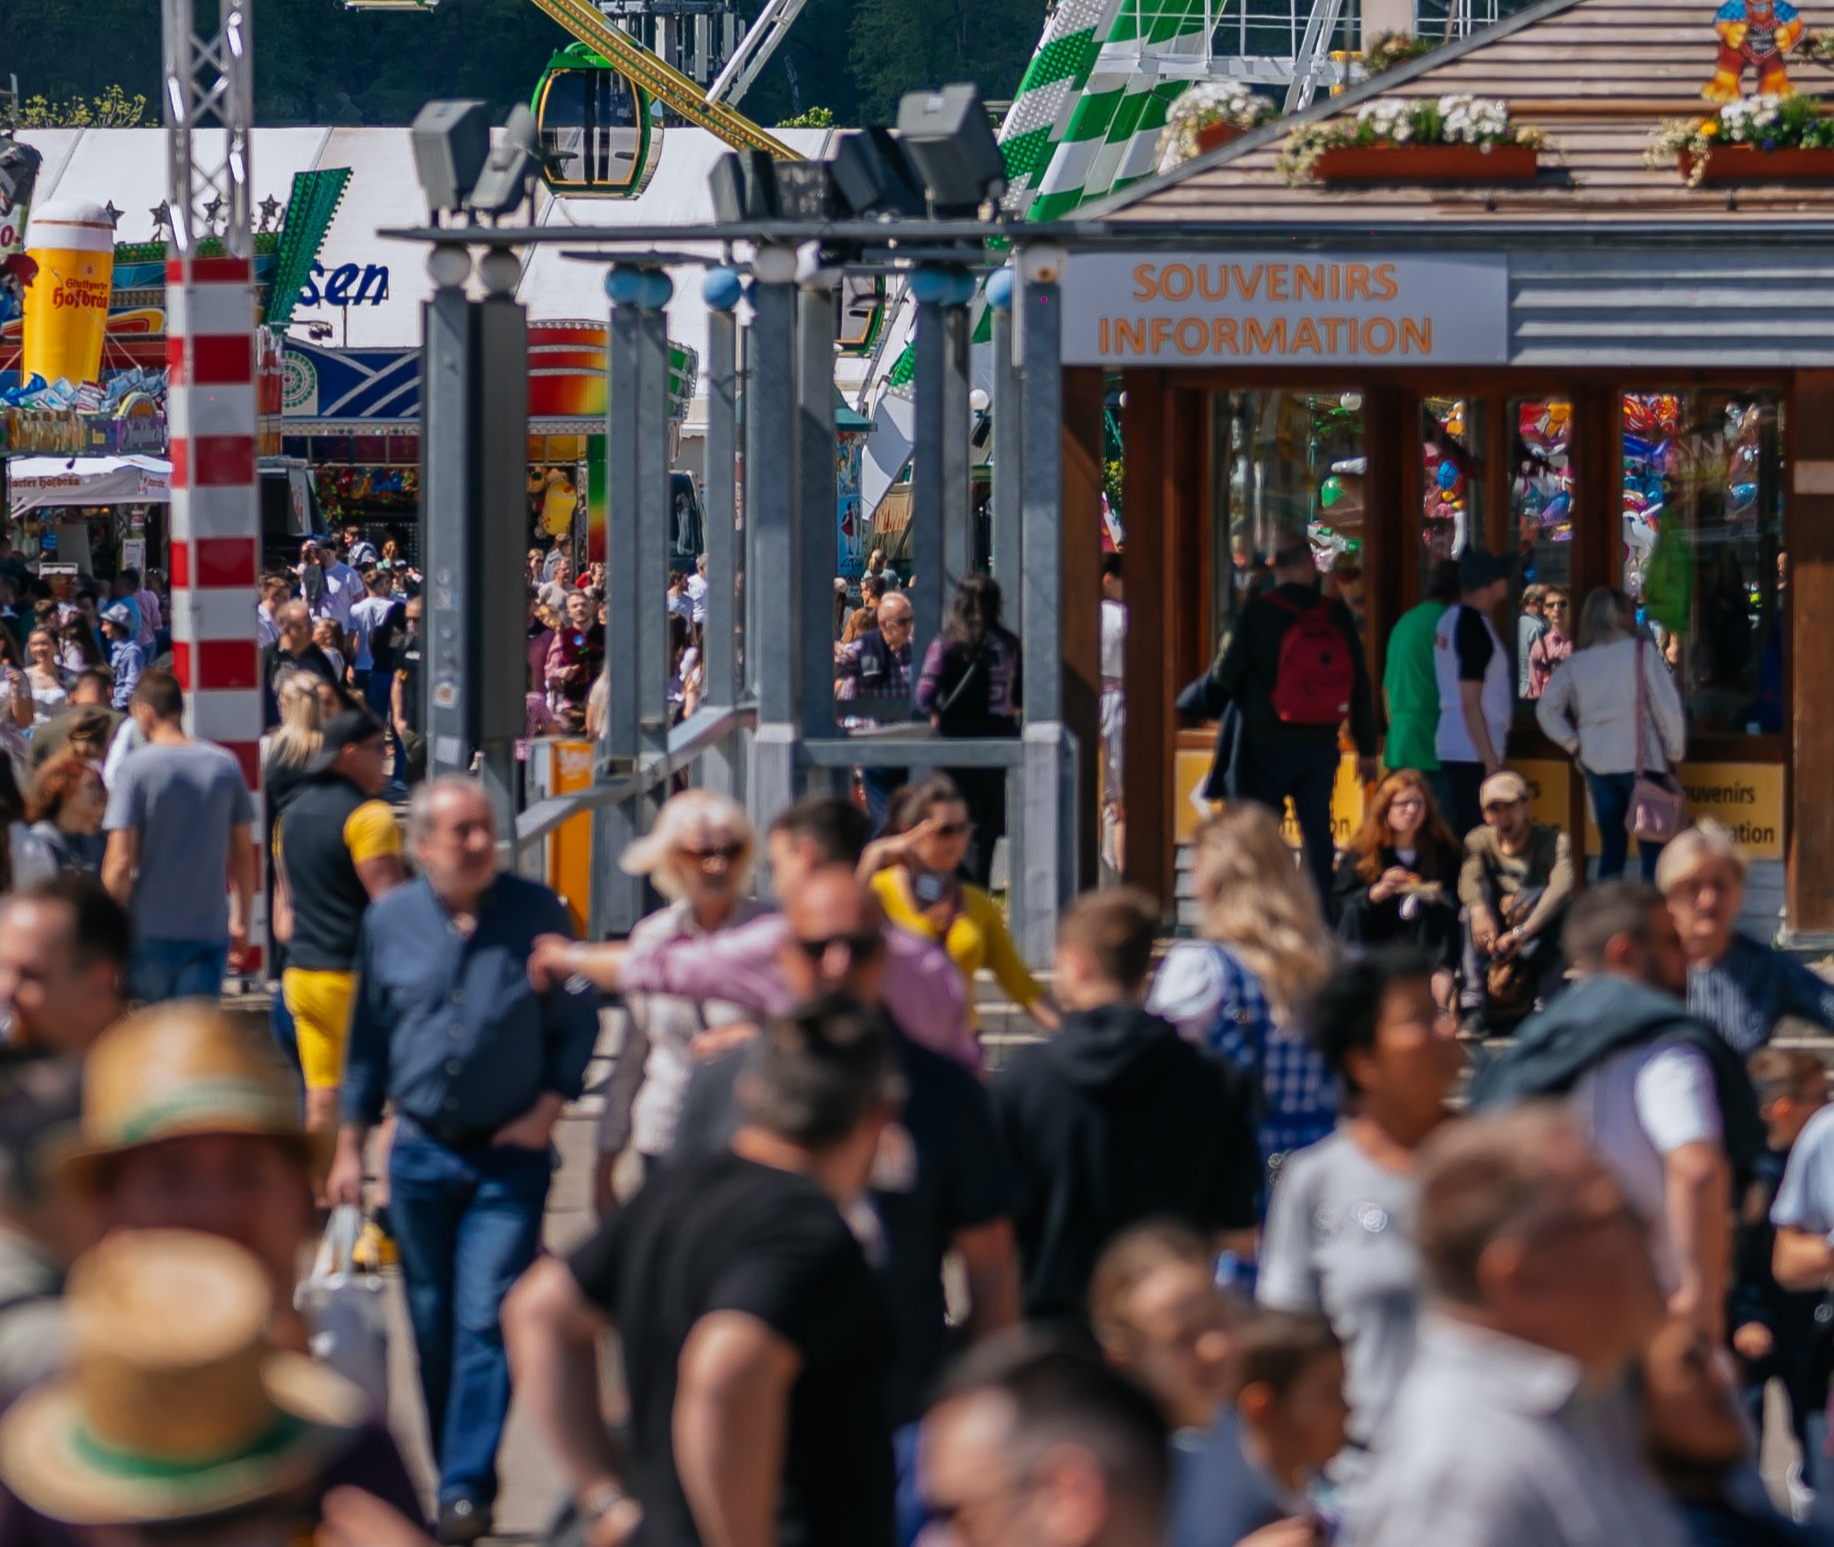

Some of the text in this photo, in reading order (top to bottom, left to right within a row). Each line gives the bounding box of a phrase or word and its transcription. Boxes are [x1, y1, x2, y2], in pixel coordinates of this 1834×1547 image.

[1133, 263, 1399, 302] SOUVENIRS
[1099, 316, 1433, 354] INFORMATION
[1682, 781, 1756, 803] uvenirs
